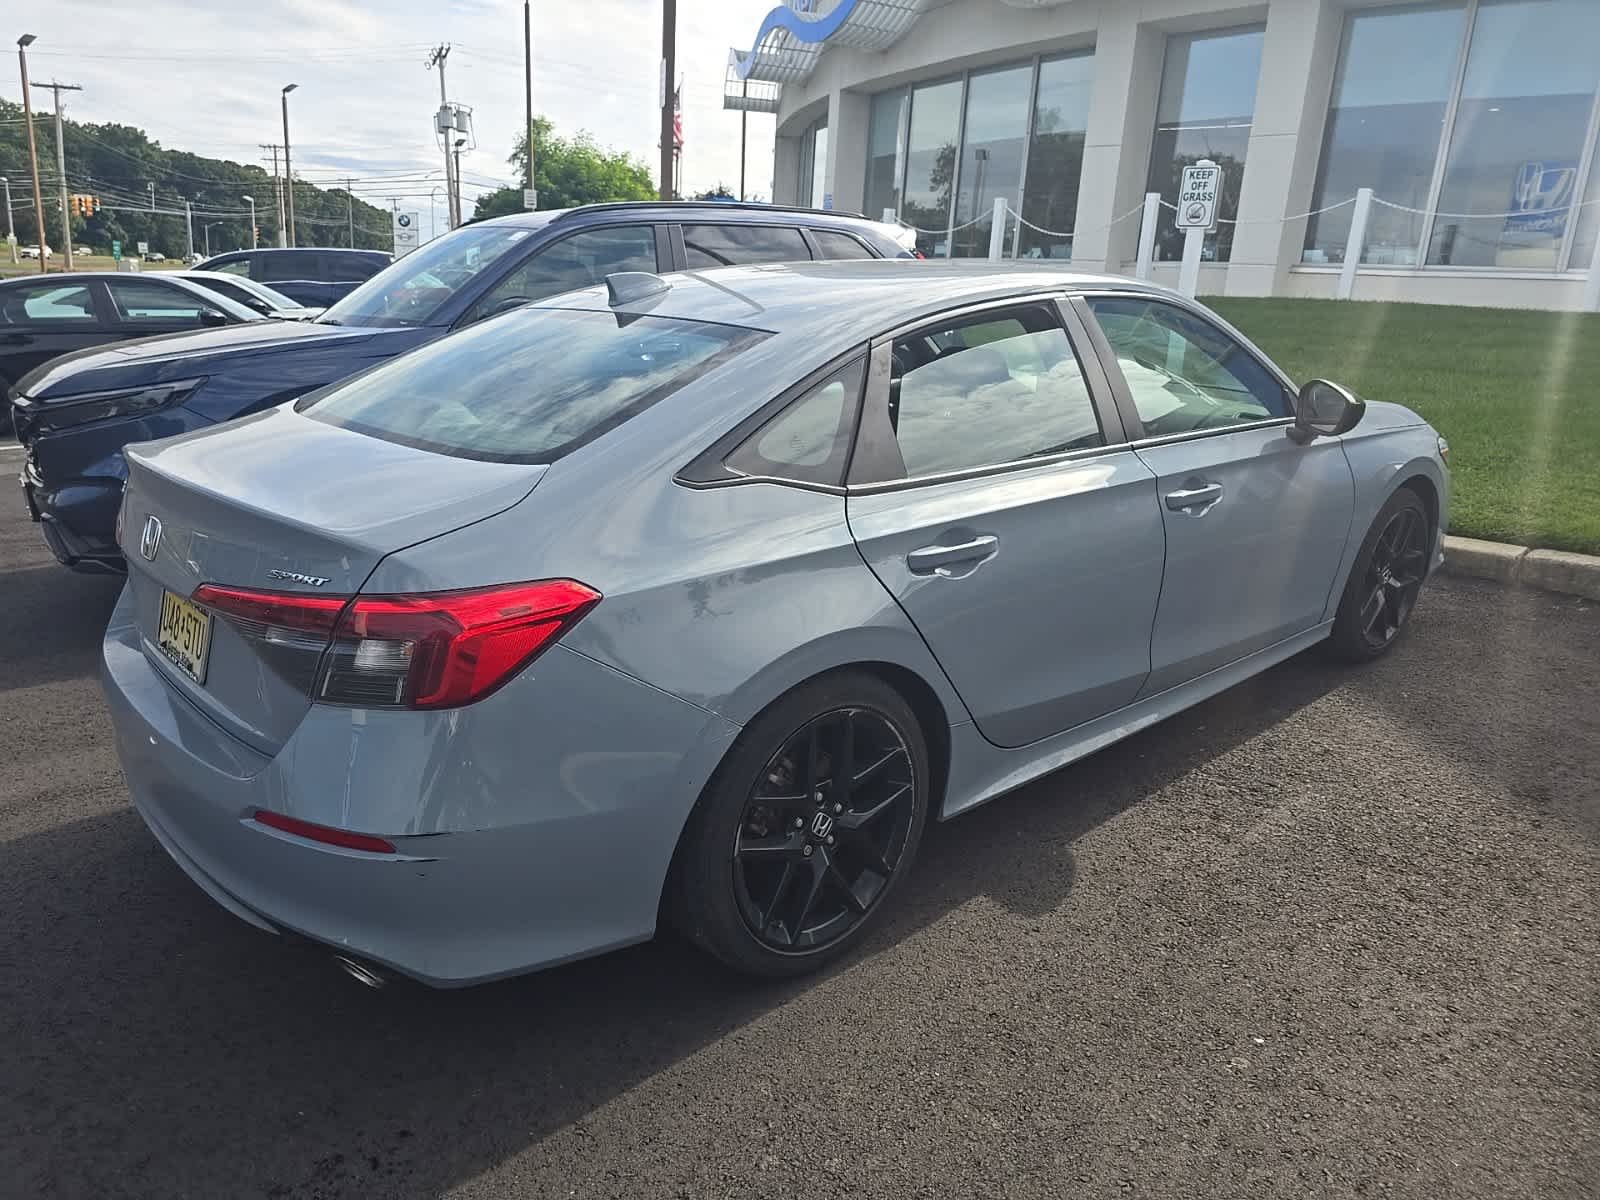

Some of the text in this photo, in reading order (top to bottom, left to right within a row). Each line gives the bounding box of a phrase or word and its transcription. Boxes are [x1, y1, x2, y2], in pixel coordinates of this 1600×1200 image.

[1189, 170, 1213, 180] KEEP
[1191, 181, 1209, 190] OFF
[1183, 192, 1213, 202] GRASS
[266, 569, 331, 587] SPORT
